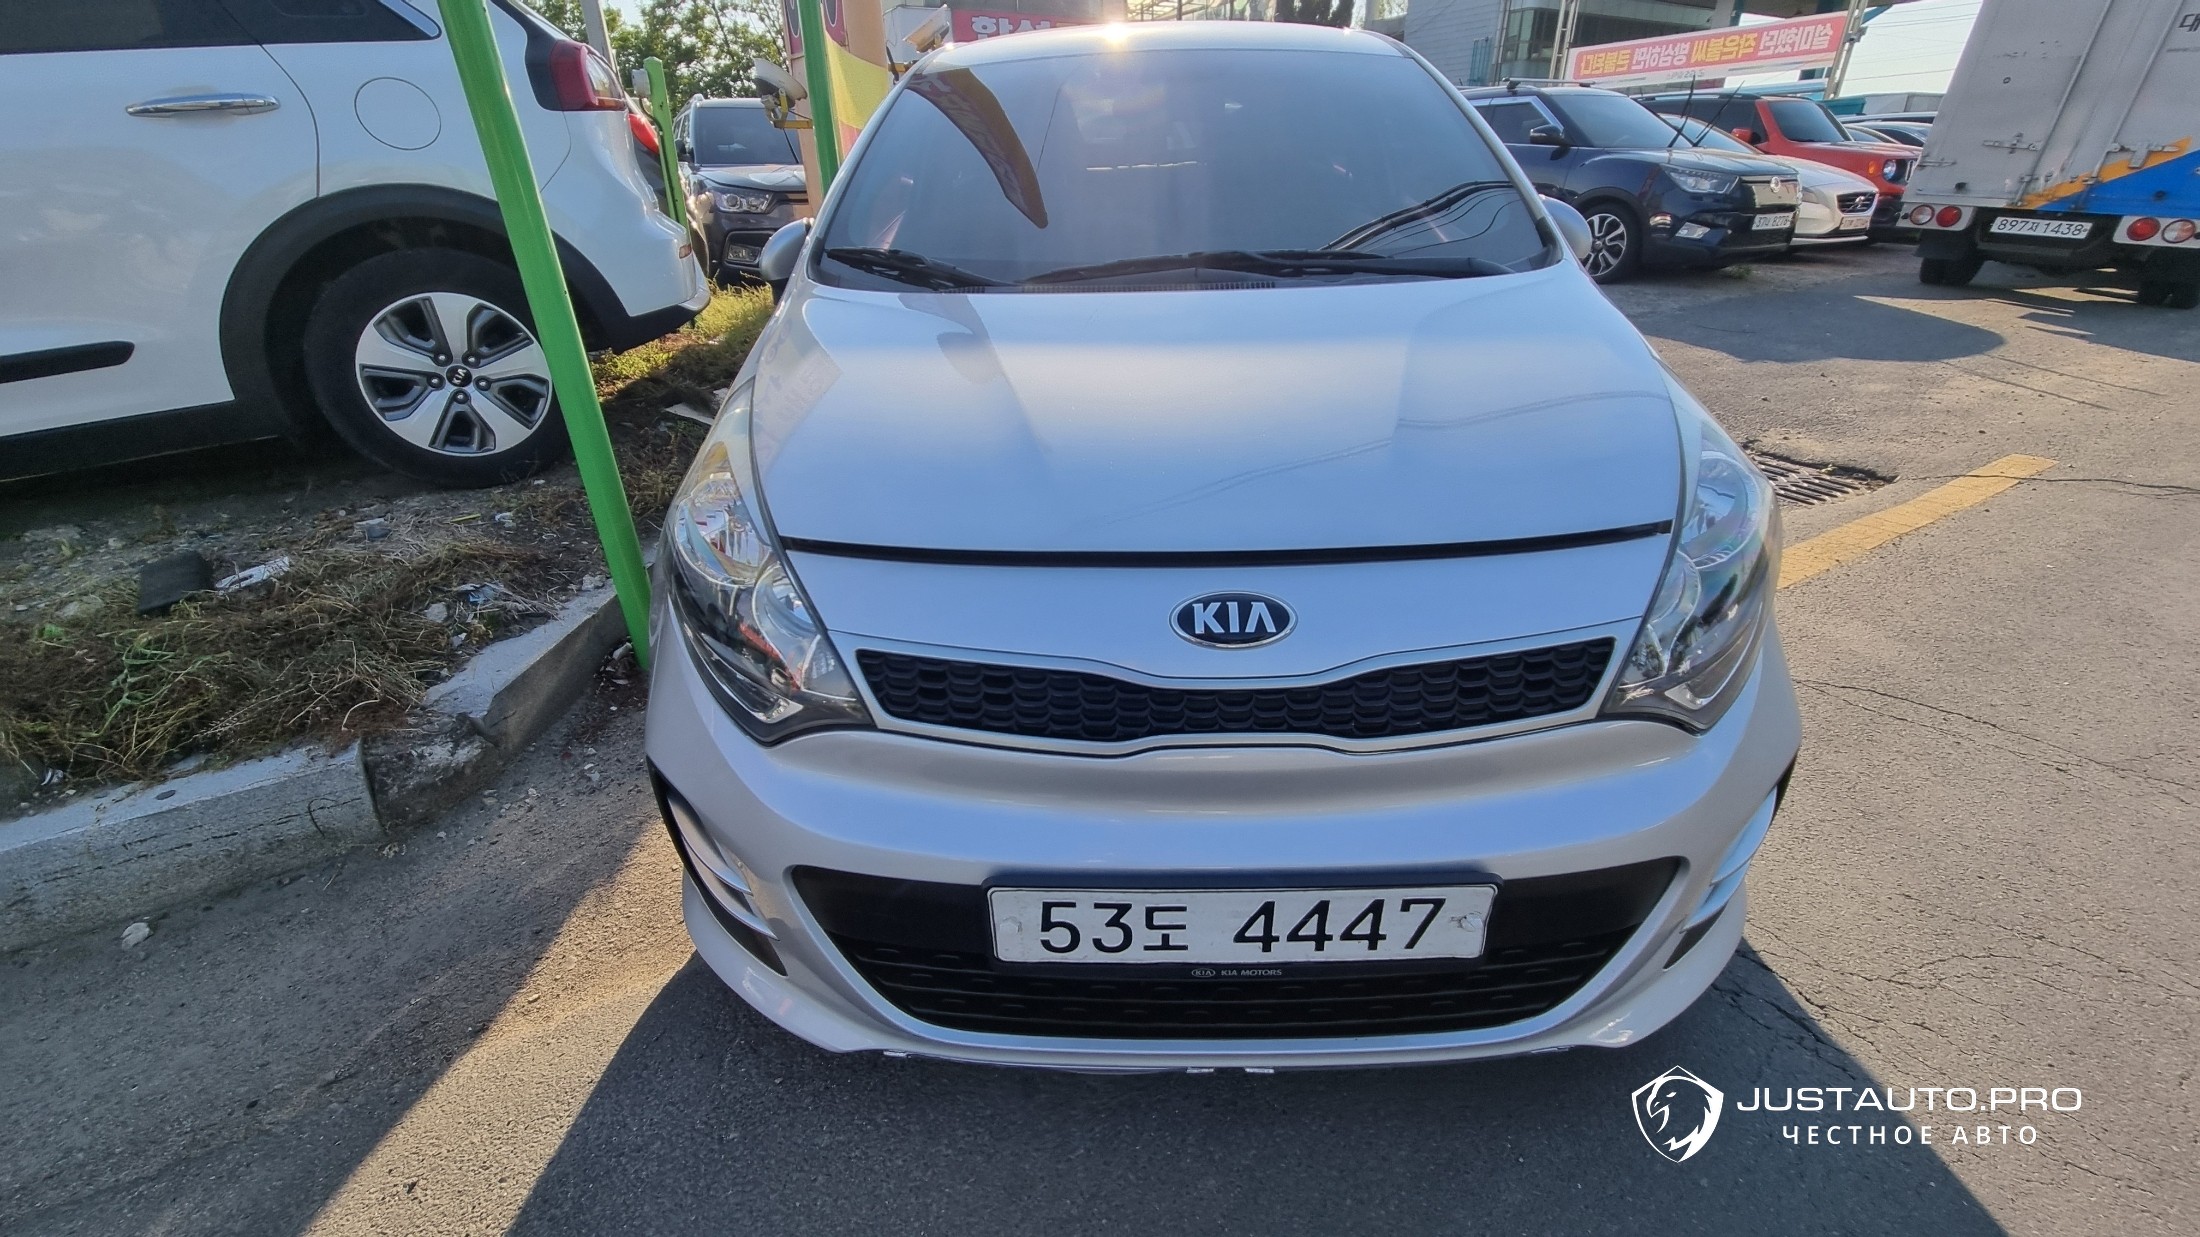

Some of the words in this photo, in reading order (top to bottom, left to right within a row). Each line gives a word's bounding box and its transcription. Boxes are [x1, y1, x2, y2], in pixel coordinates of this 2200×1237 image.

[1997, 219, 2040, 232] 897저
[2043, 222, 2084, 236] 1438
[452, 369, 467, 384] KIA
[1192, 601, 1277, 635] KIA
[1039, 901, 1189, 954] 53도
[1232, 897, 1447, 953] 4447
